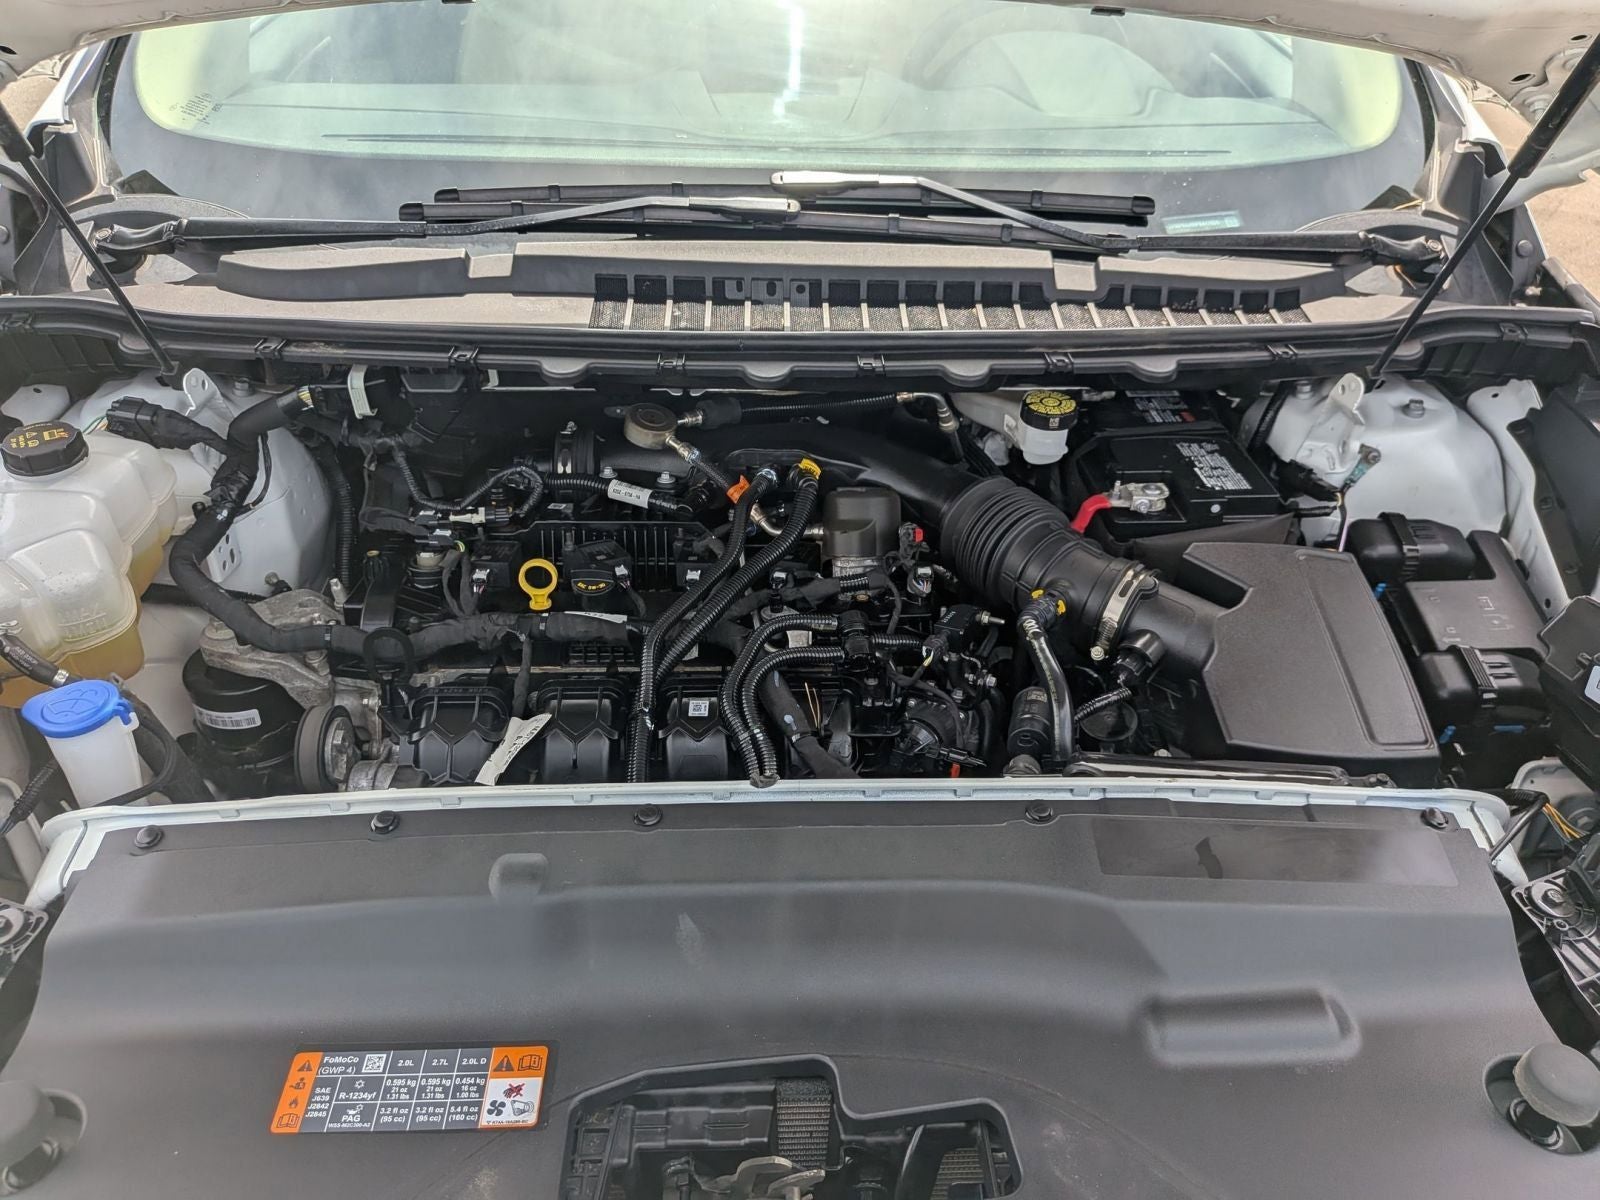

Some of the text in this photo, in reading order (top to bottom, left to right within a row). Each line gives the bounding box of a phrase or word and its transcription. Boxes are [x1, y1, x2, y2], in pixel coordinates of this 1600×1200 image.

[324, 1056, 360, 1064] FoMoCo
[318, 1066, 356, 1074] (GWP 4)
[406, 1078, 416, 1087] kg
[441, 1078, 451, 1086] kg
[476, 1077, 485, 1086] kg
[339, 1092, 377, 1101] R-1234yf
